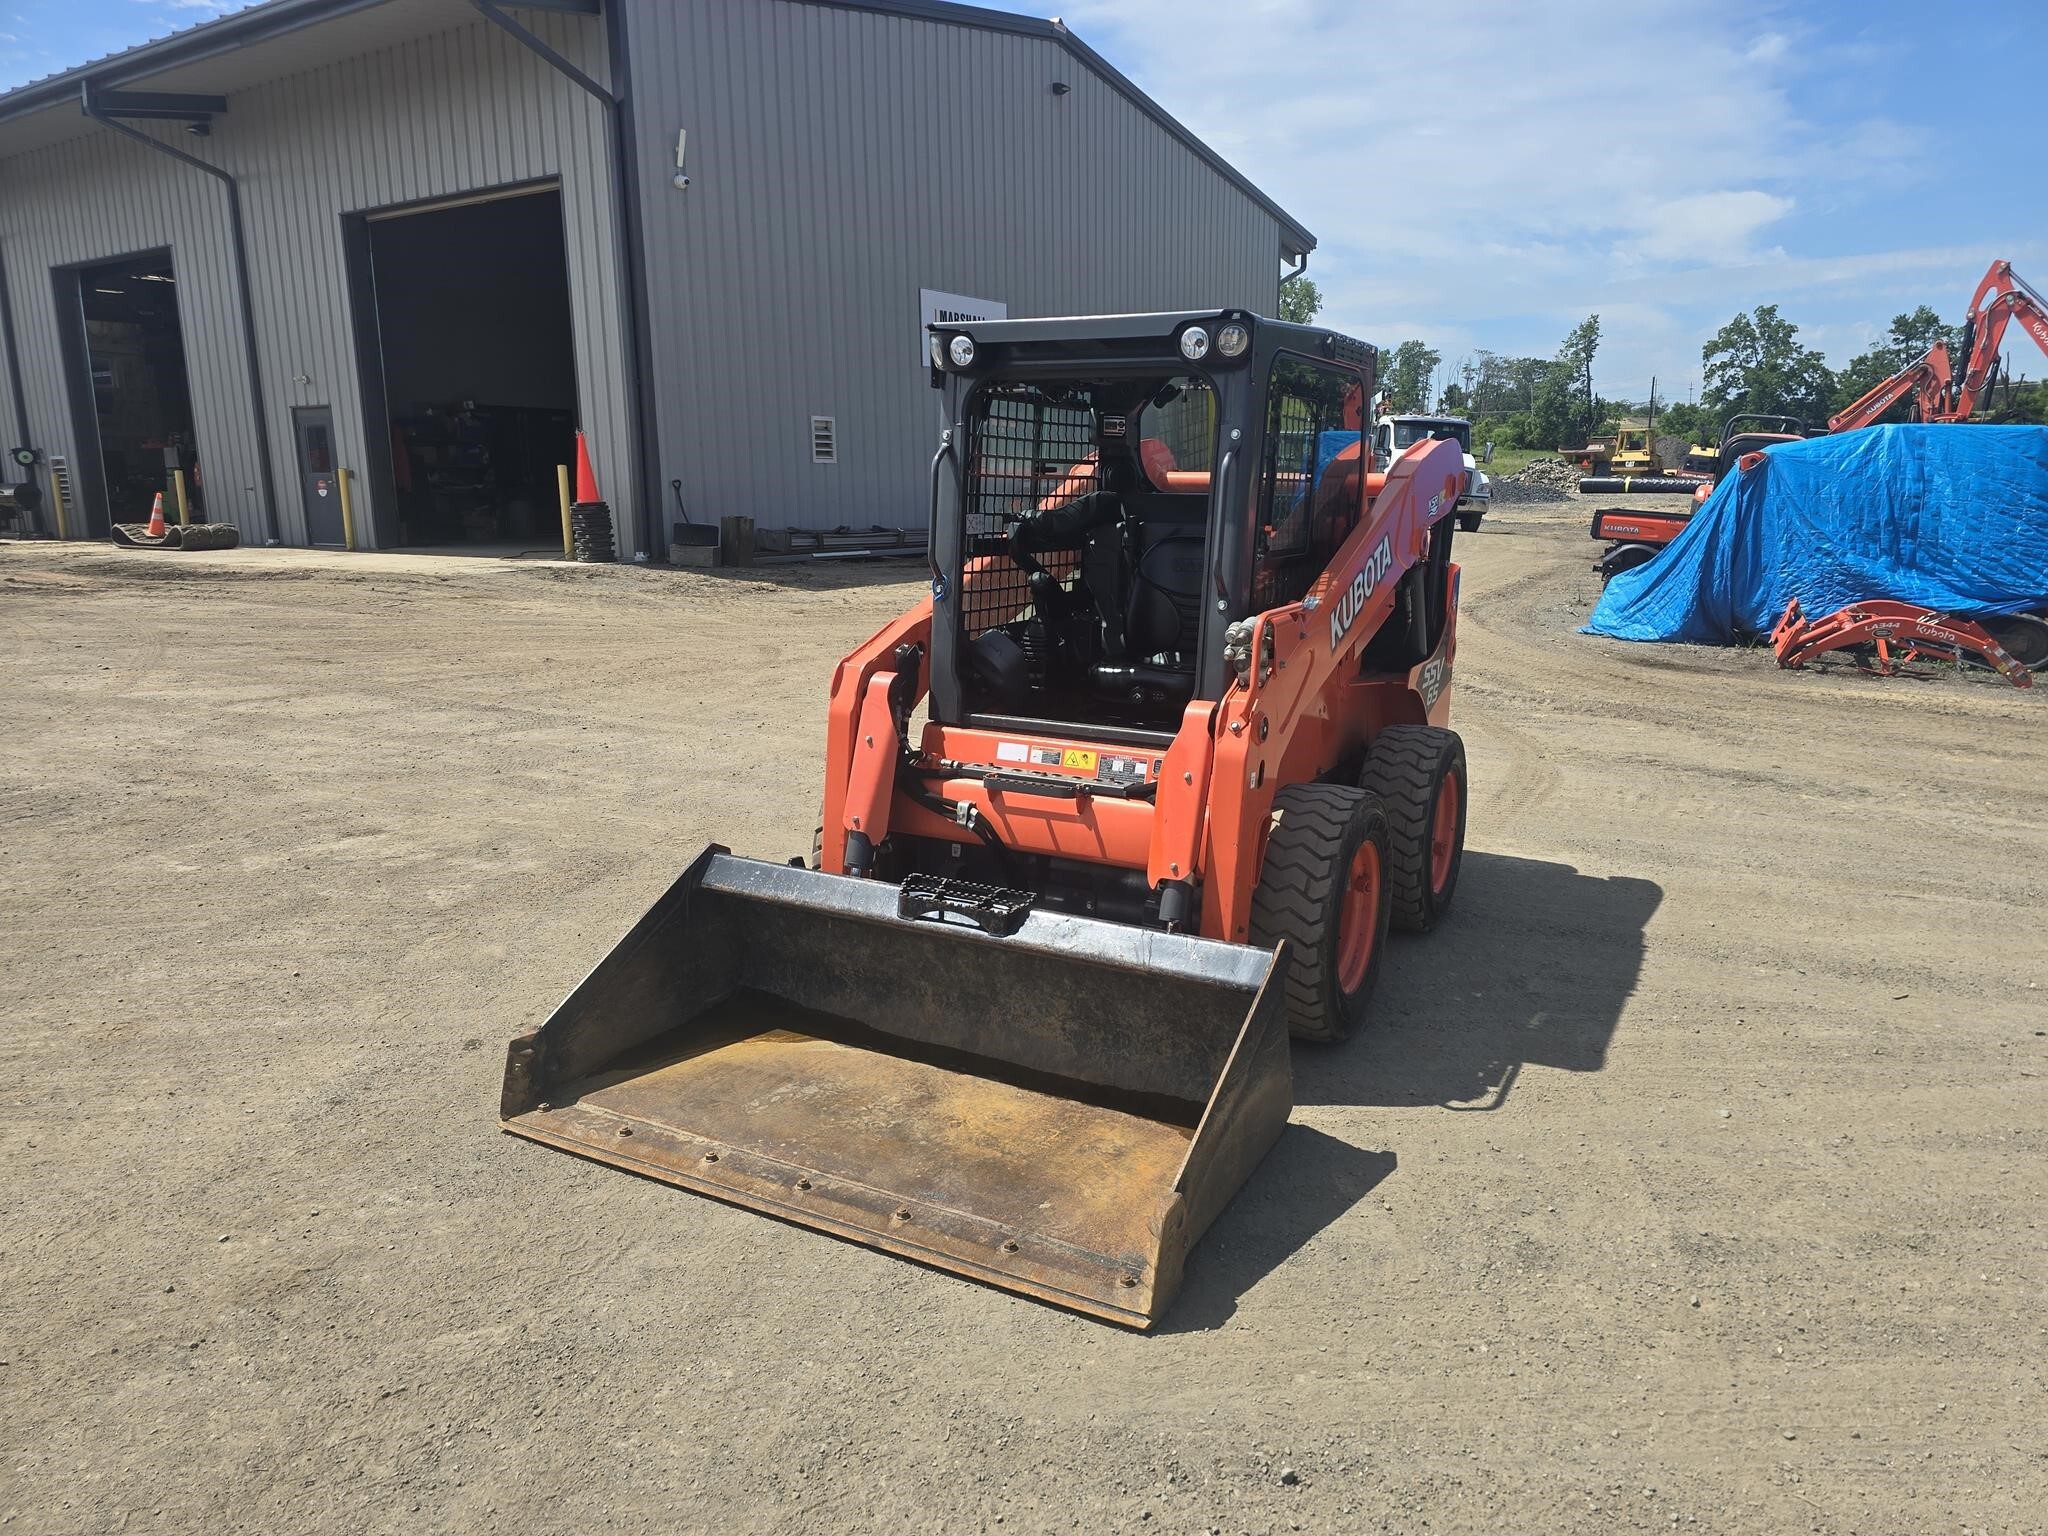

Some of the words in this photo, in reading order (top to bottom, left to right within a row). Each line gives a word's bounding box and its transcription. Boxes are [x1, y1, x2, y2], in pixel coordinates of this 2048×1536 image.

[939, 309, 986, 322] MARSHA
[1865, 393, 1894, 415] KUBOTA
[1604, 525, 1639, 534] KUBOTA
[1330, 535, 1392, 650] KUBOTA
[1915, 625, 1956, 641] Kubota
[1422, 656, 1446, 690] SSV
[1426, 683, 1440, 706] 65
